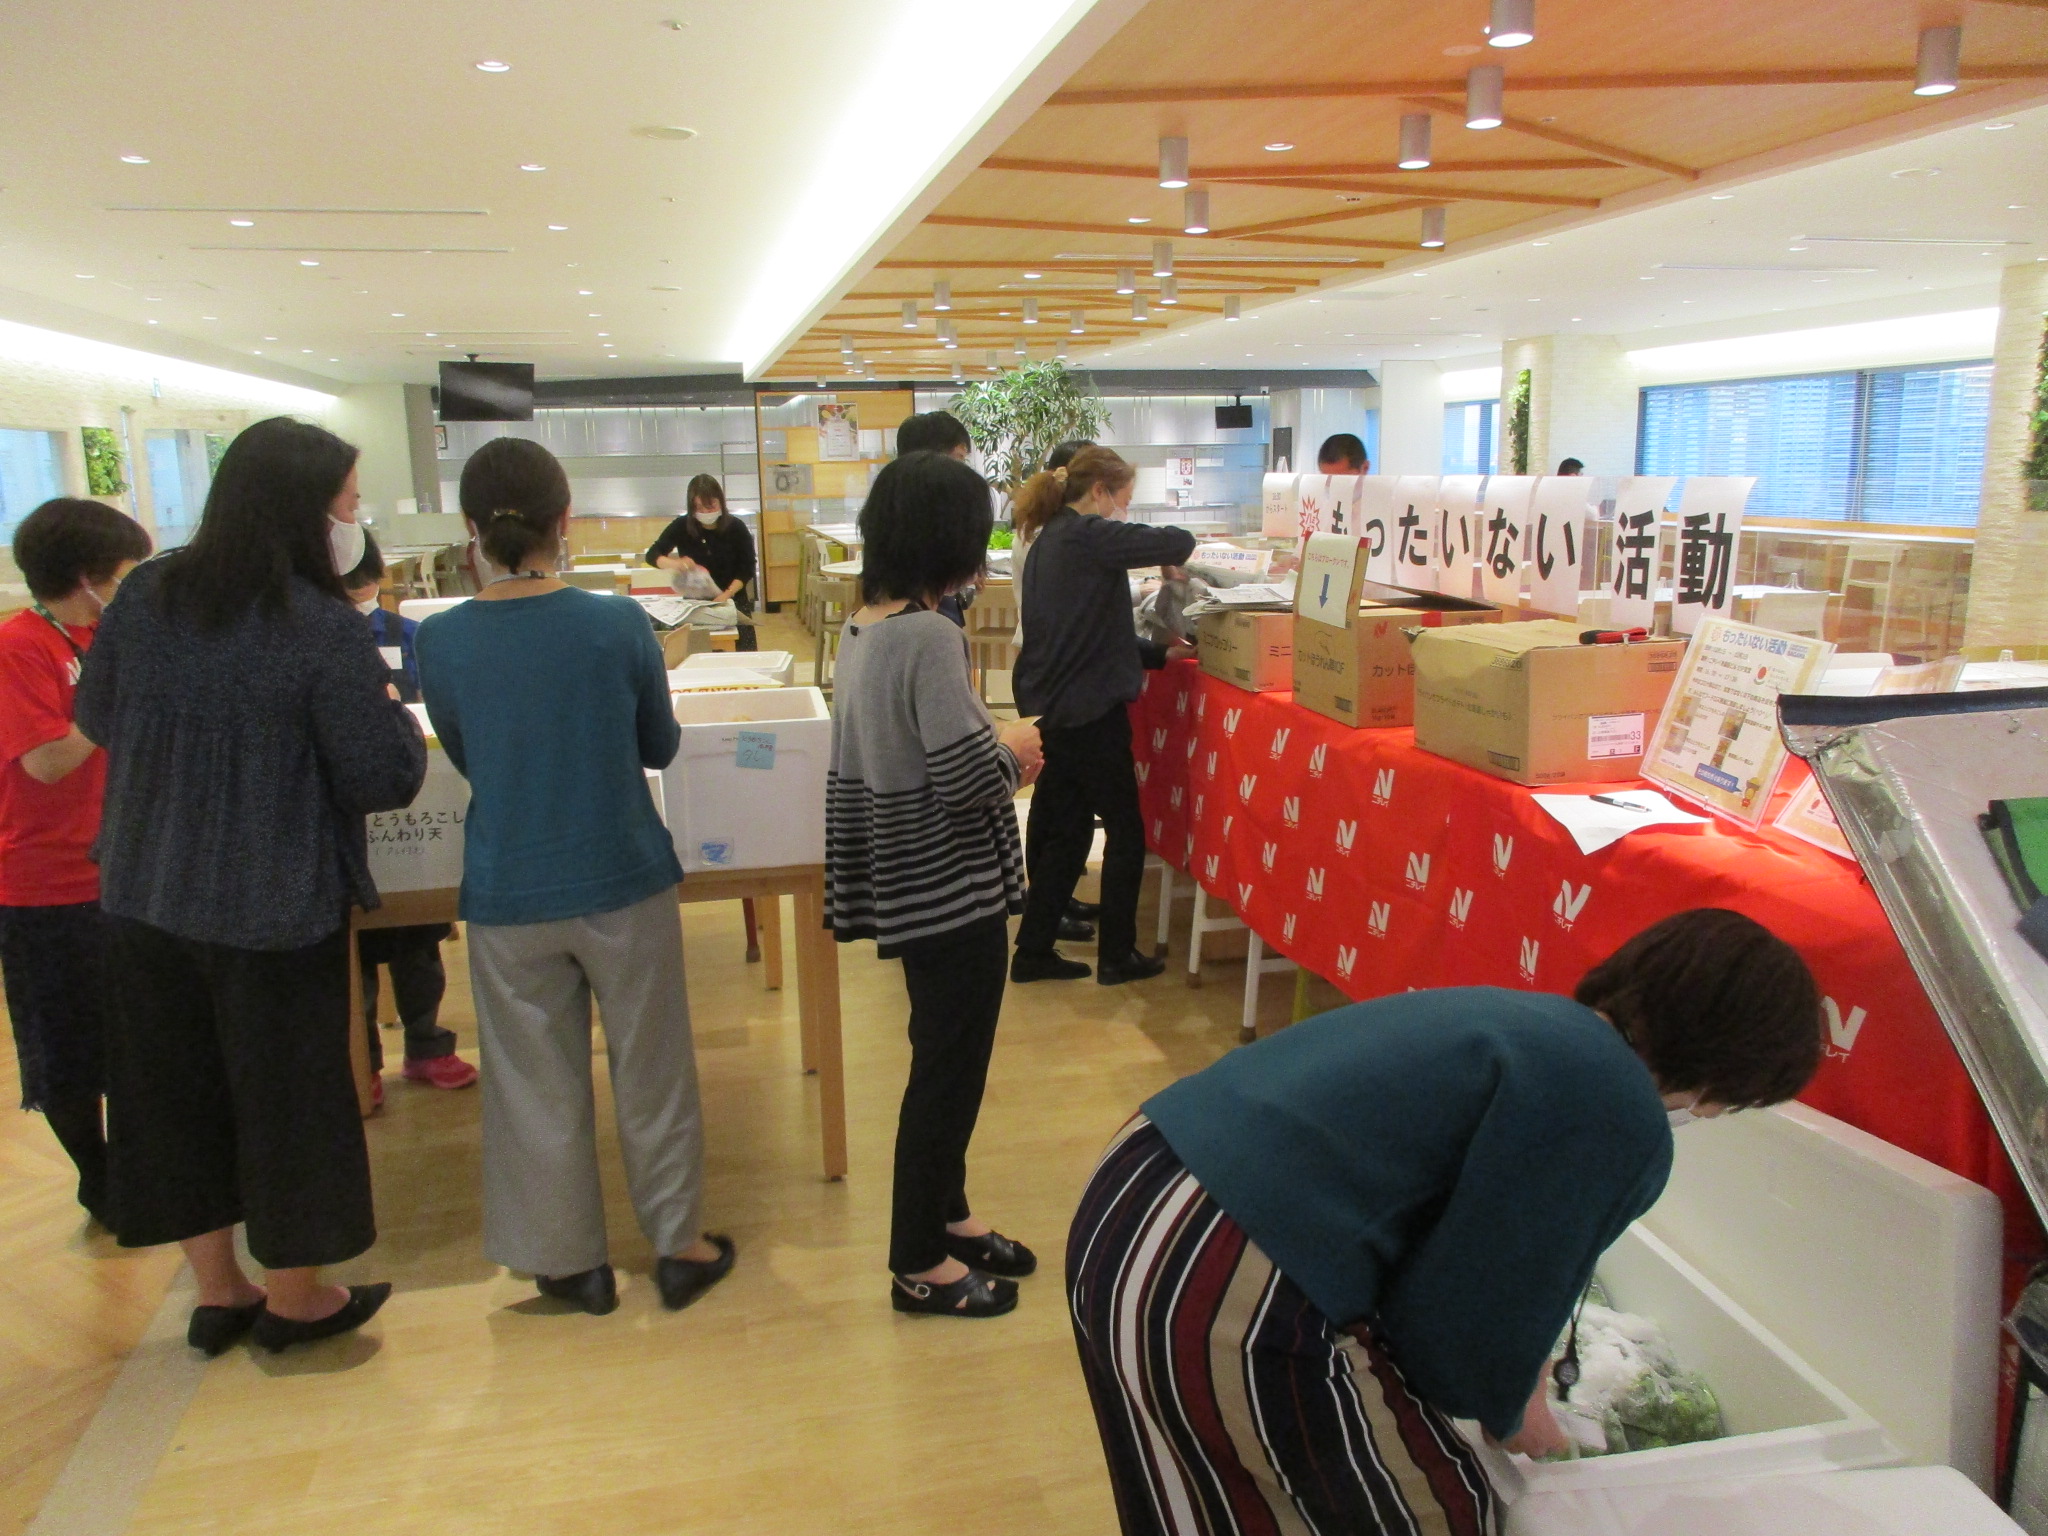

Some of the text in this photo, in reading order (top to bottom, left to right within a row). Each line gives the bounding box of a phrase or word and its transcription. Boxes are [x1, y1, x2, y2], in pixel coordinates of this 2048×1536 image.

[1722, 629, 1788, 655] もったいない活動
[1630, 731, 1641, 740] 33
[374, 811, 464, 827] とうもろこし
[368, 828, 442, 843] ふんわり天
